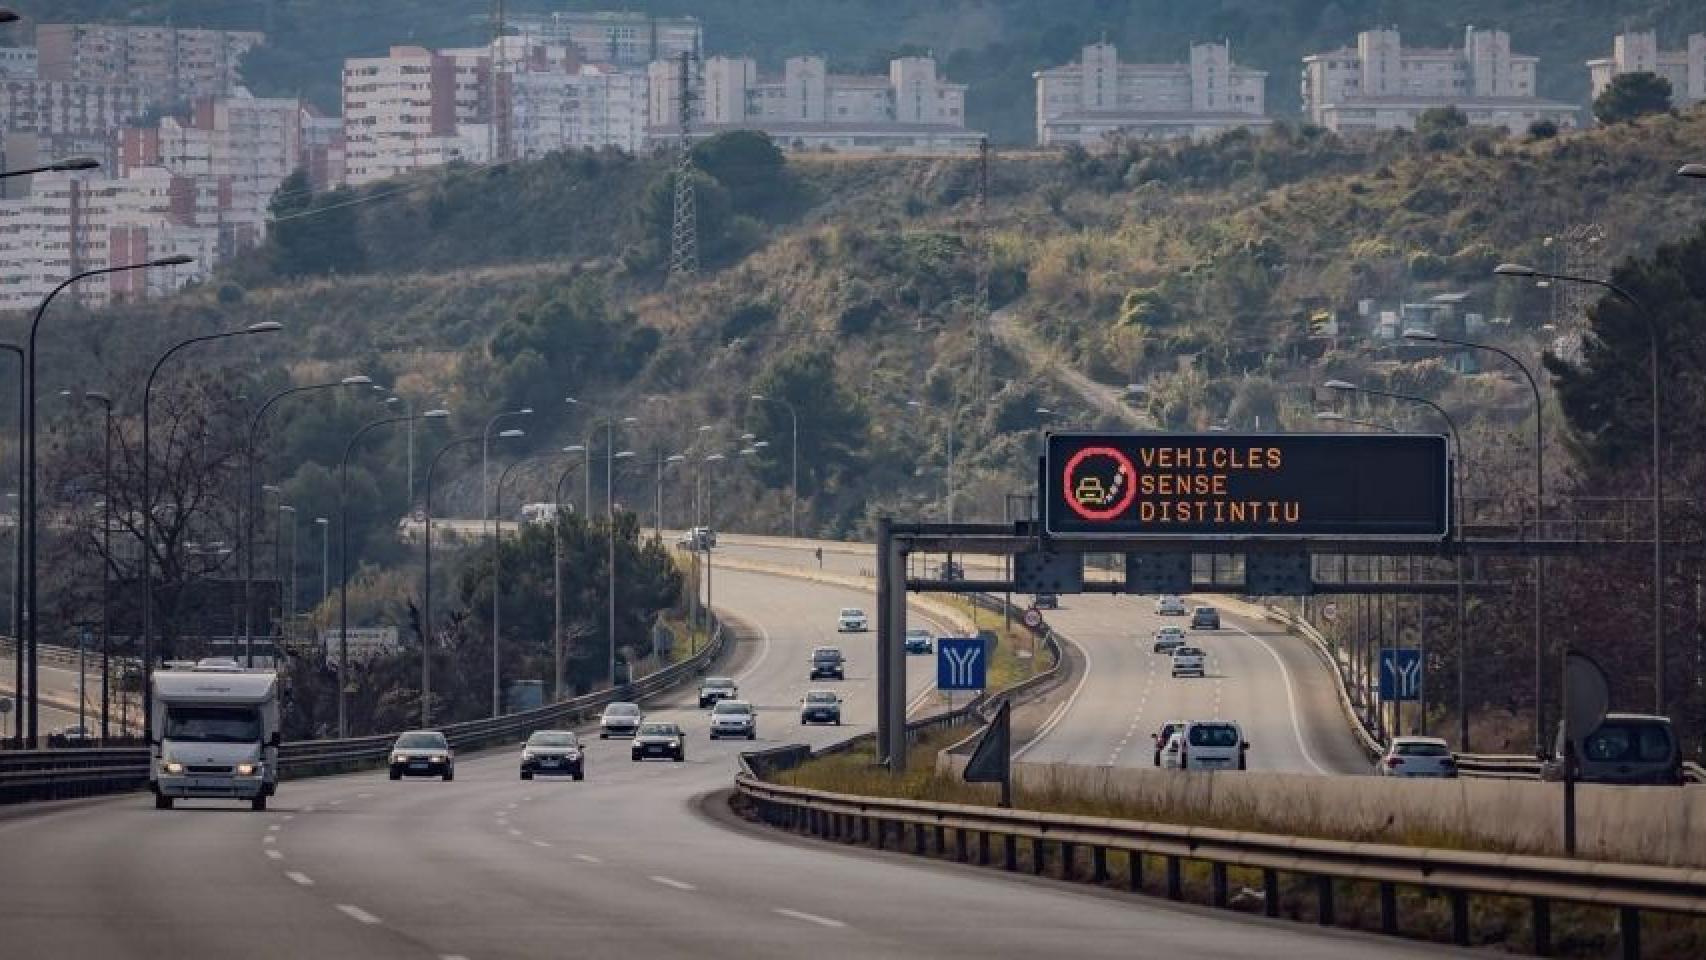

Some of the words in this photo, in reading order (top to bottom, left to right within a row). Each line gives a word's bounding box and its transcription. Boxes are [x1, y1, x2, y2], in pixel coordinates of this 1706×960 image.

[1141, 447, 1282, 468] VEHICLES
[1141, 475, 1228, 495] SENSE
[1141, 501, 1300, 522] DISTINTIU
